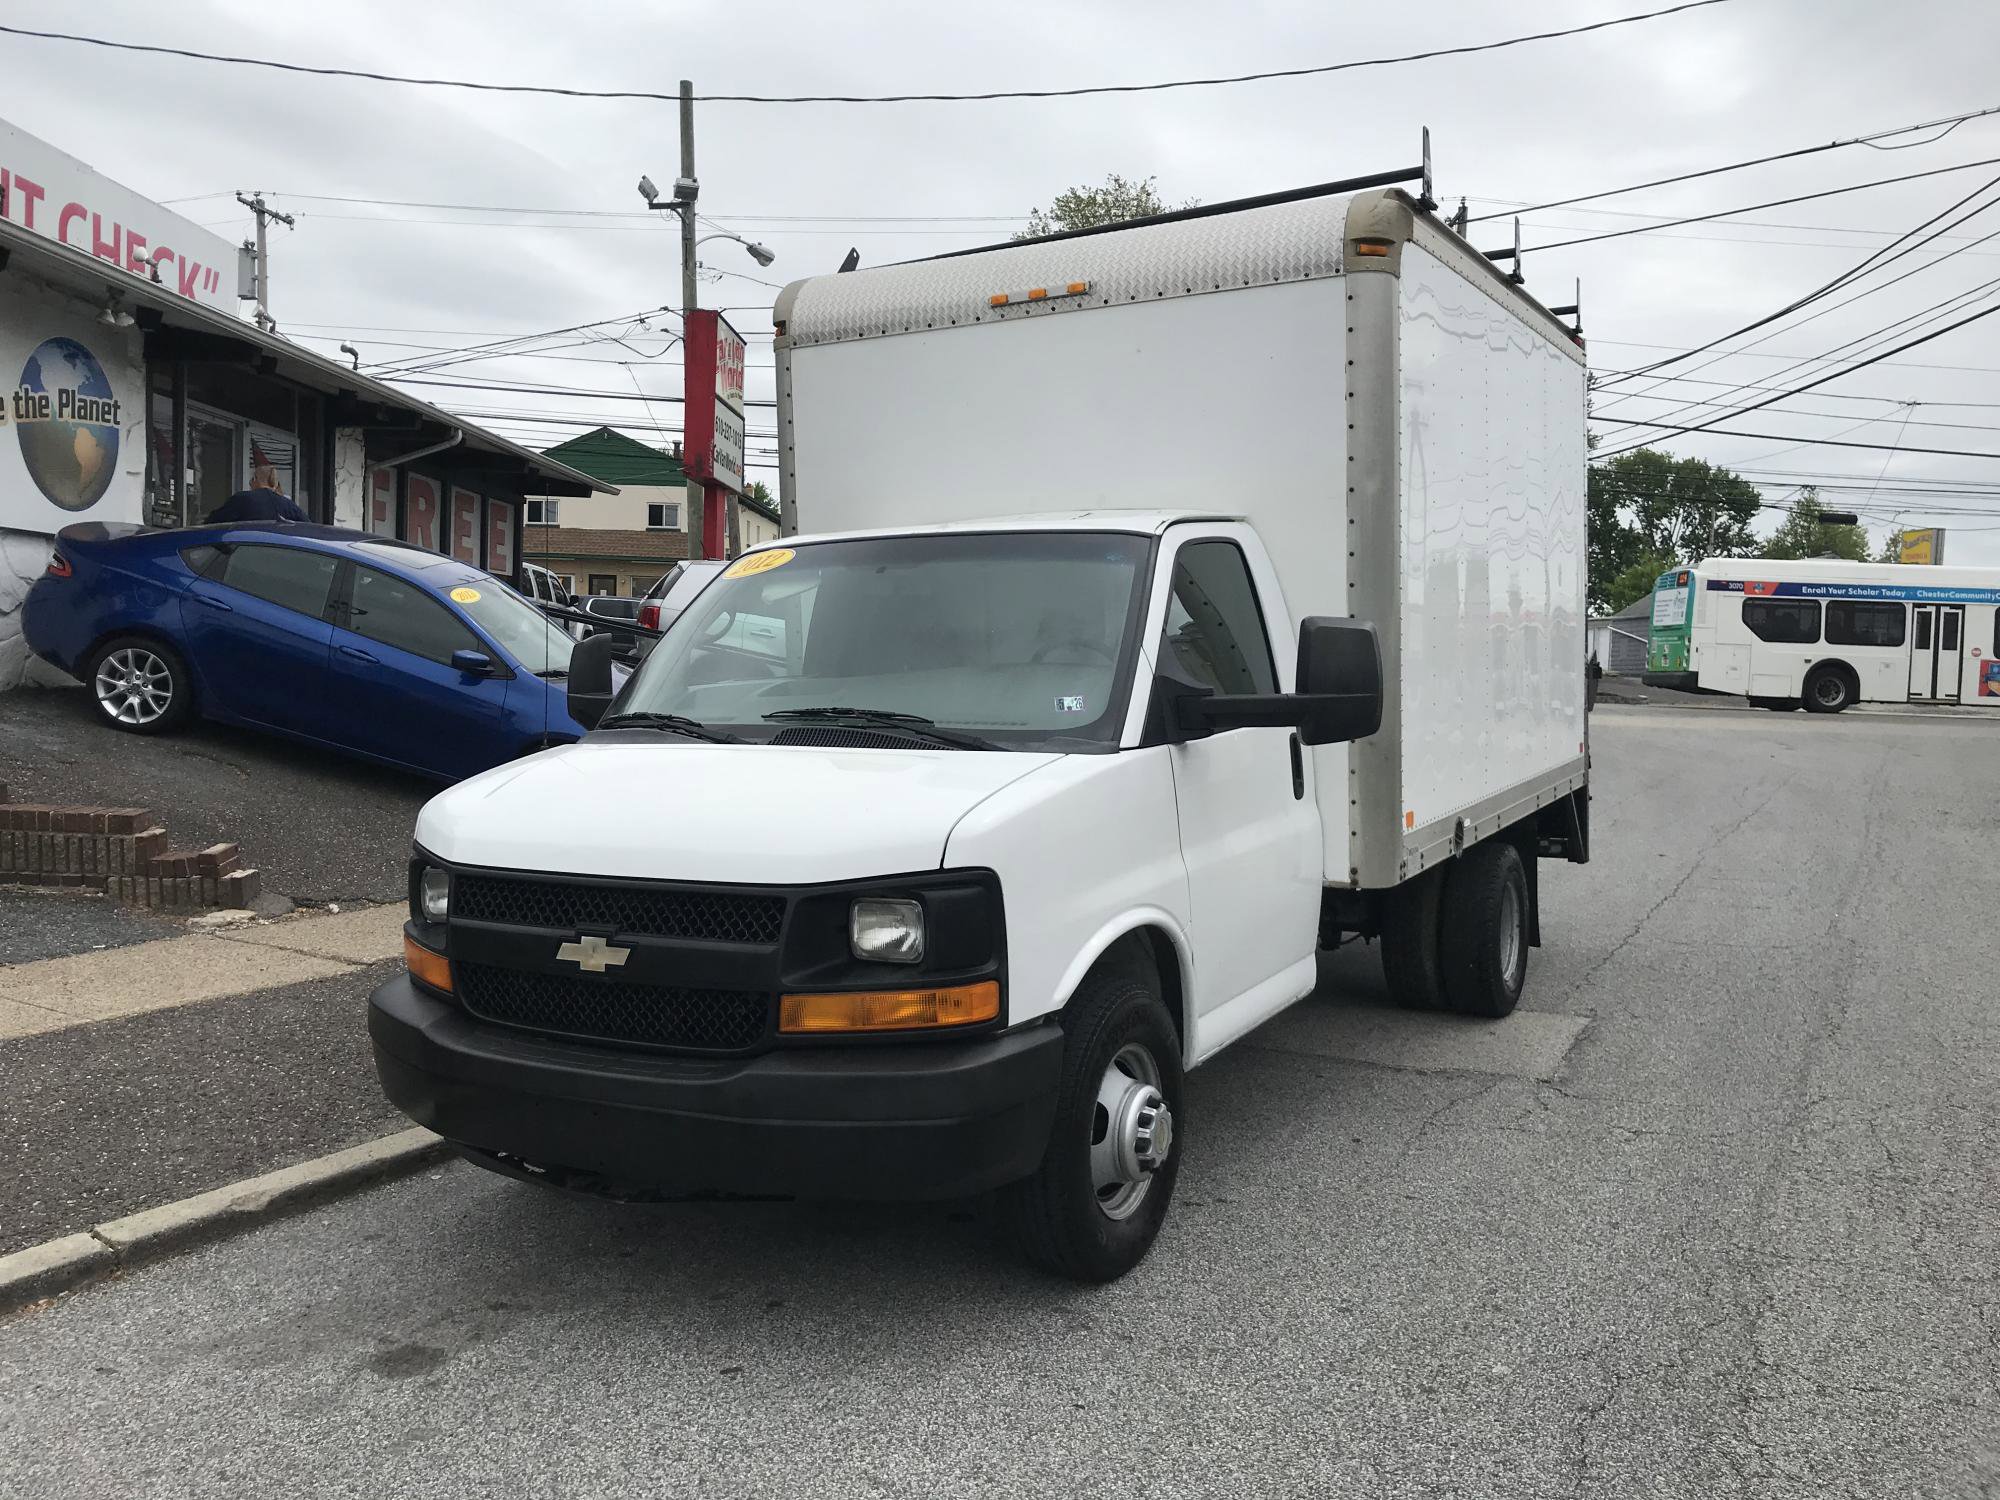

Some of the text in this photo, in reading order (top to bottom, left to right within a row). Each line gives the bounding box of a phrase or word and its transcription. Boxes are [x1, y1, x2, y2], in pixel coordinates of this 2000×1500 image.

[13, 388, 49, 419] the
[58, 388, 121, 425] Planet
[373, 469, 508, 572] FREE
[1802, 586, 1827, 595] Enroll
[1828, 587, 1848, 595] Your
[1848, 588, 1879, 596] Scholar
[1881, 589, 1906, 598] Today
